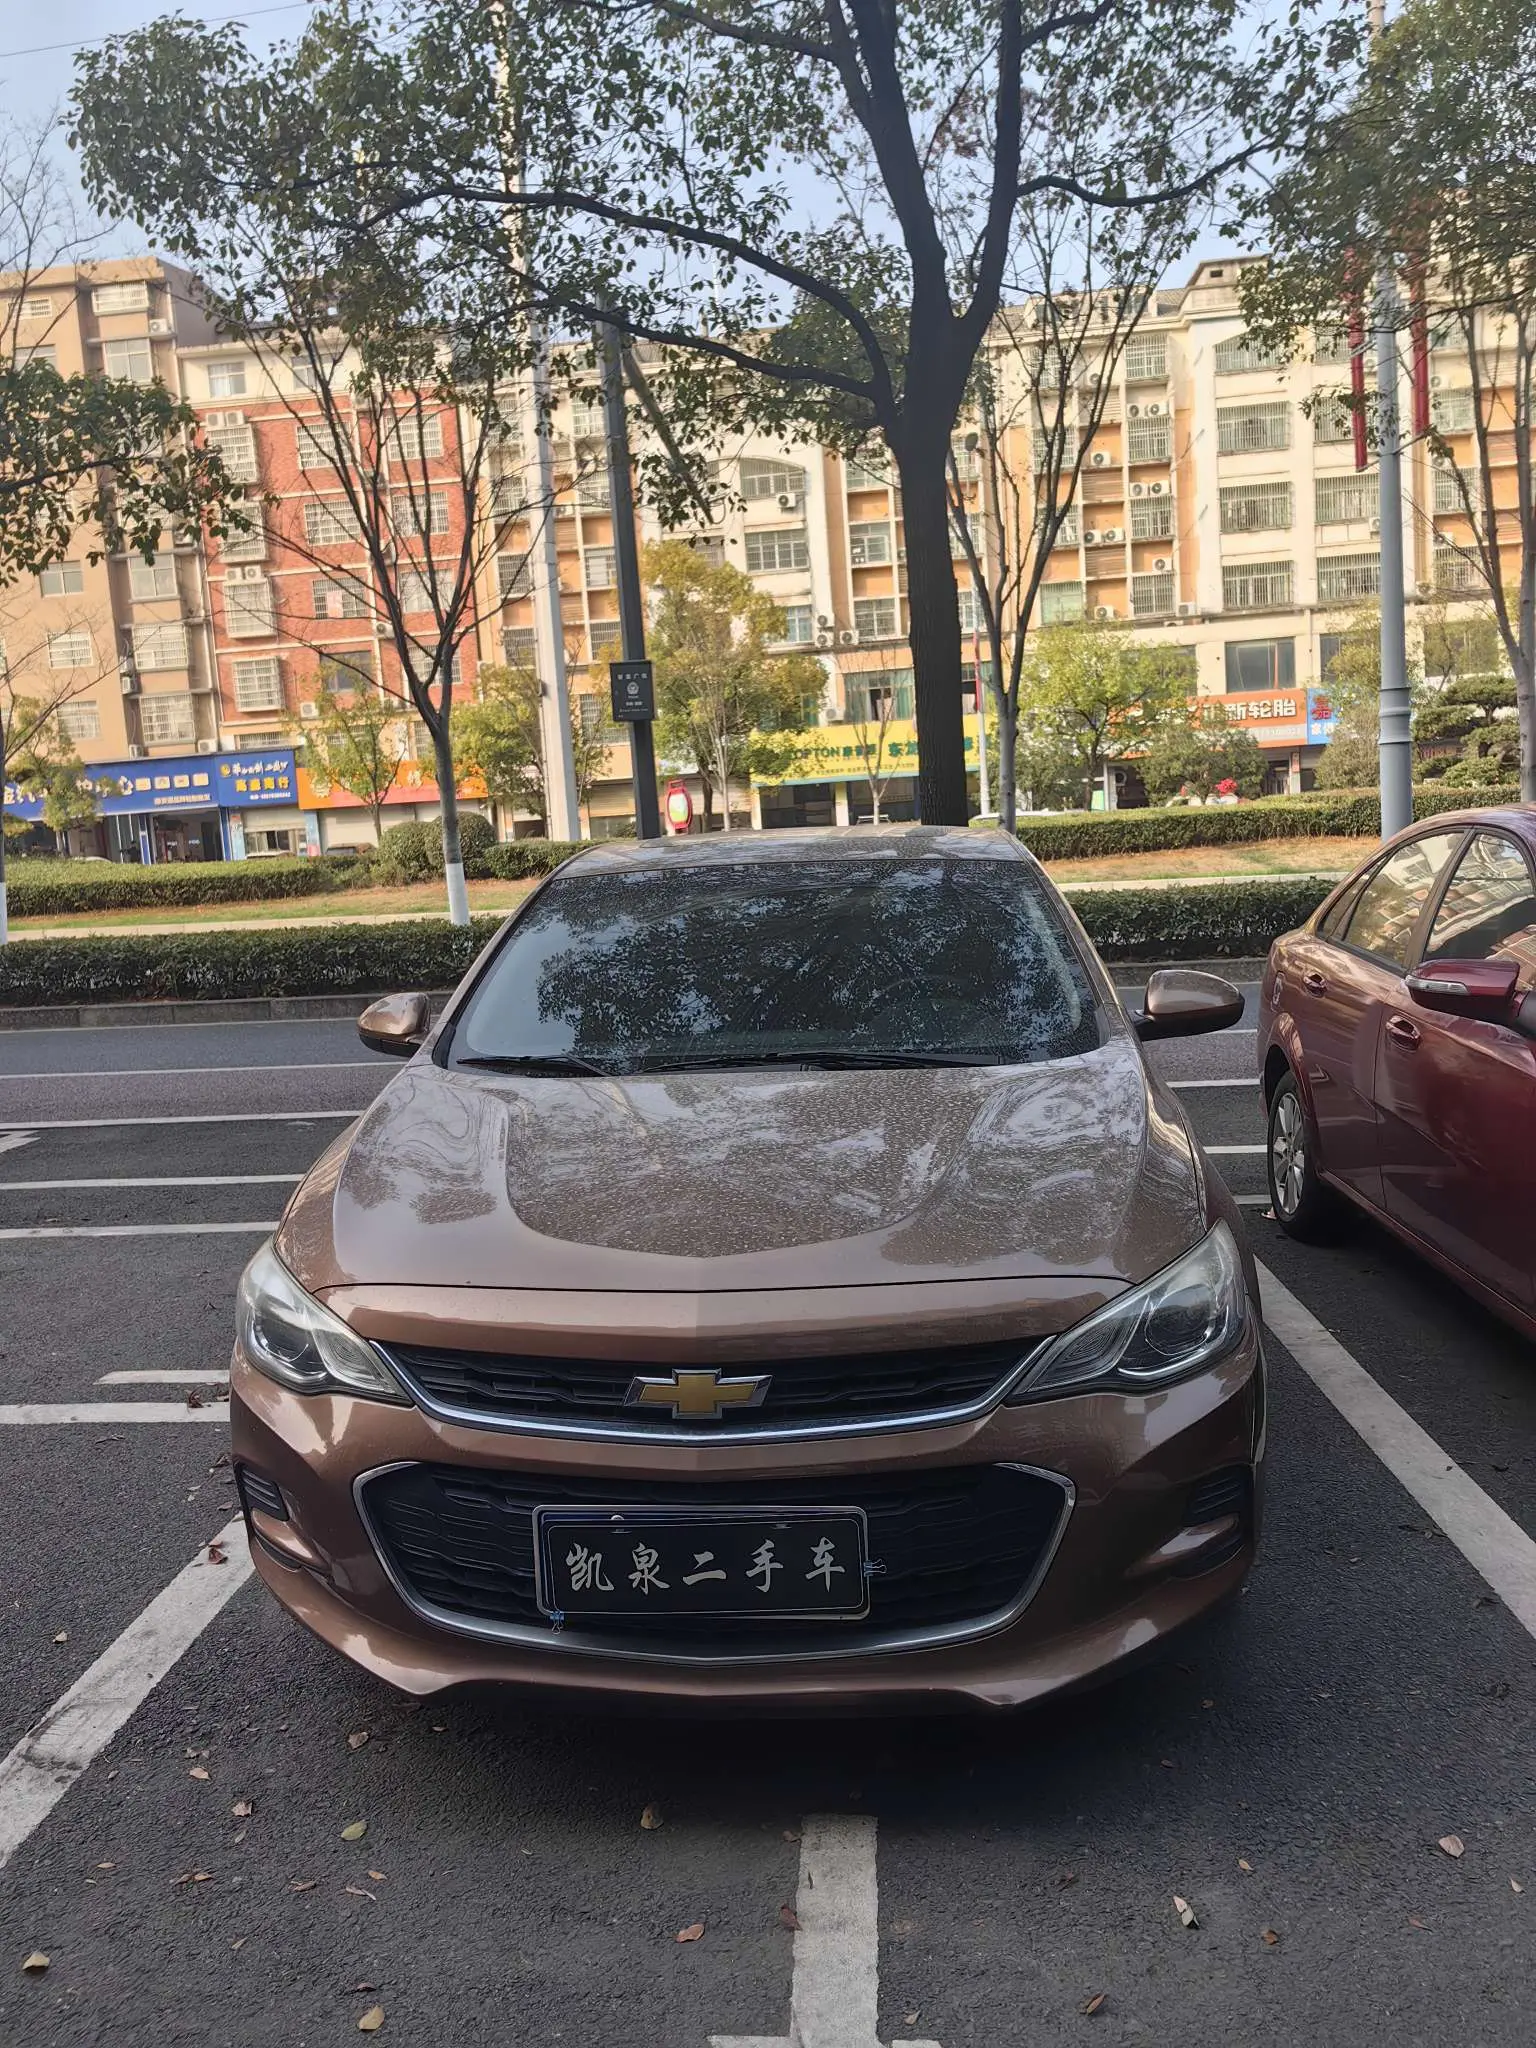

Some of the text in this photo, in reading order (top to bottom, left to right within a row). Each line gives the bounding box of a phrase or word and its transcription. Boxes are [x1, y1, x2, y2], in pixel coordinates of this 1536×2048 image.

[565, 1536, 846, 1595] 凯泉二手车
